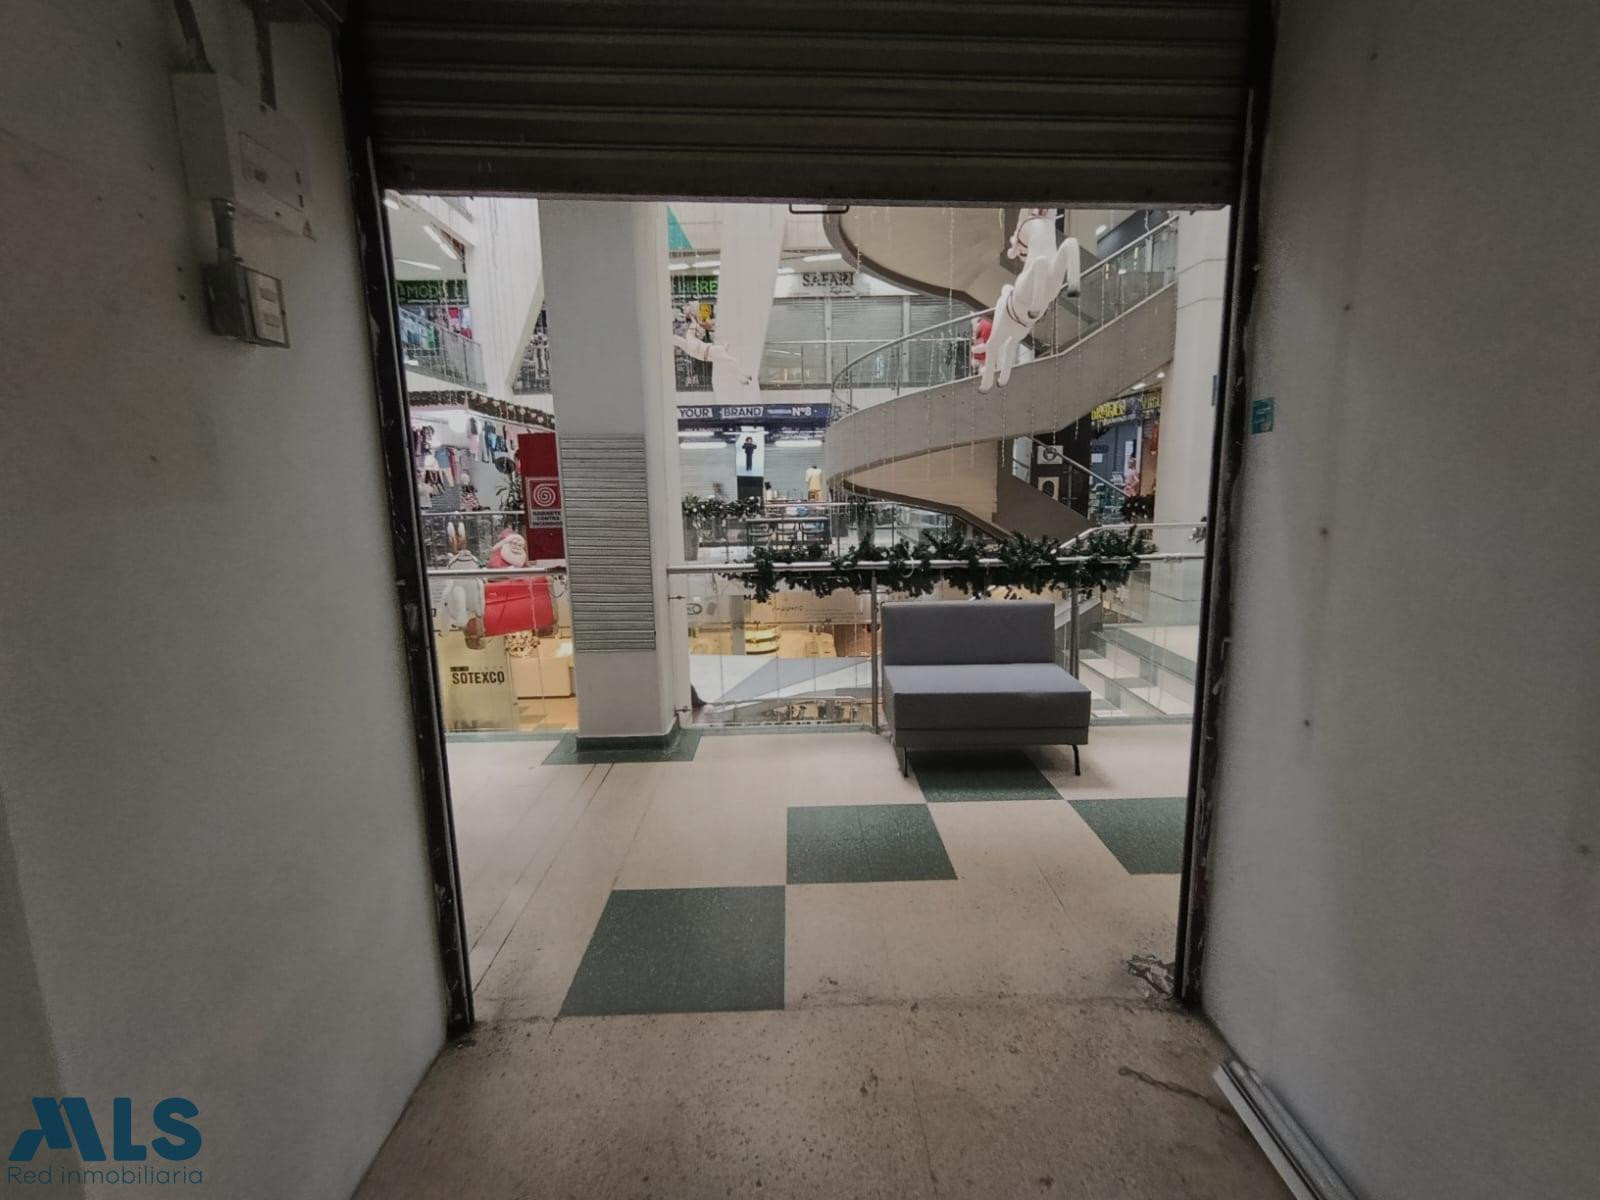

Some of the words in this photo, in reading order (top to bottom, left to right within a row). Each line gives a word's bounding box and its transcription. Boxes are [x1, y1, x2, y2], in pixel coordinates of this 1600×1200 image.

[802, 272, 855, 287] SAFARI
[680, 409, 710, 418] YOUR
[723, 406, 763, 417] BRAND
[451, 671, 505, 685] SOTEXCO
